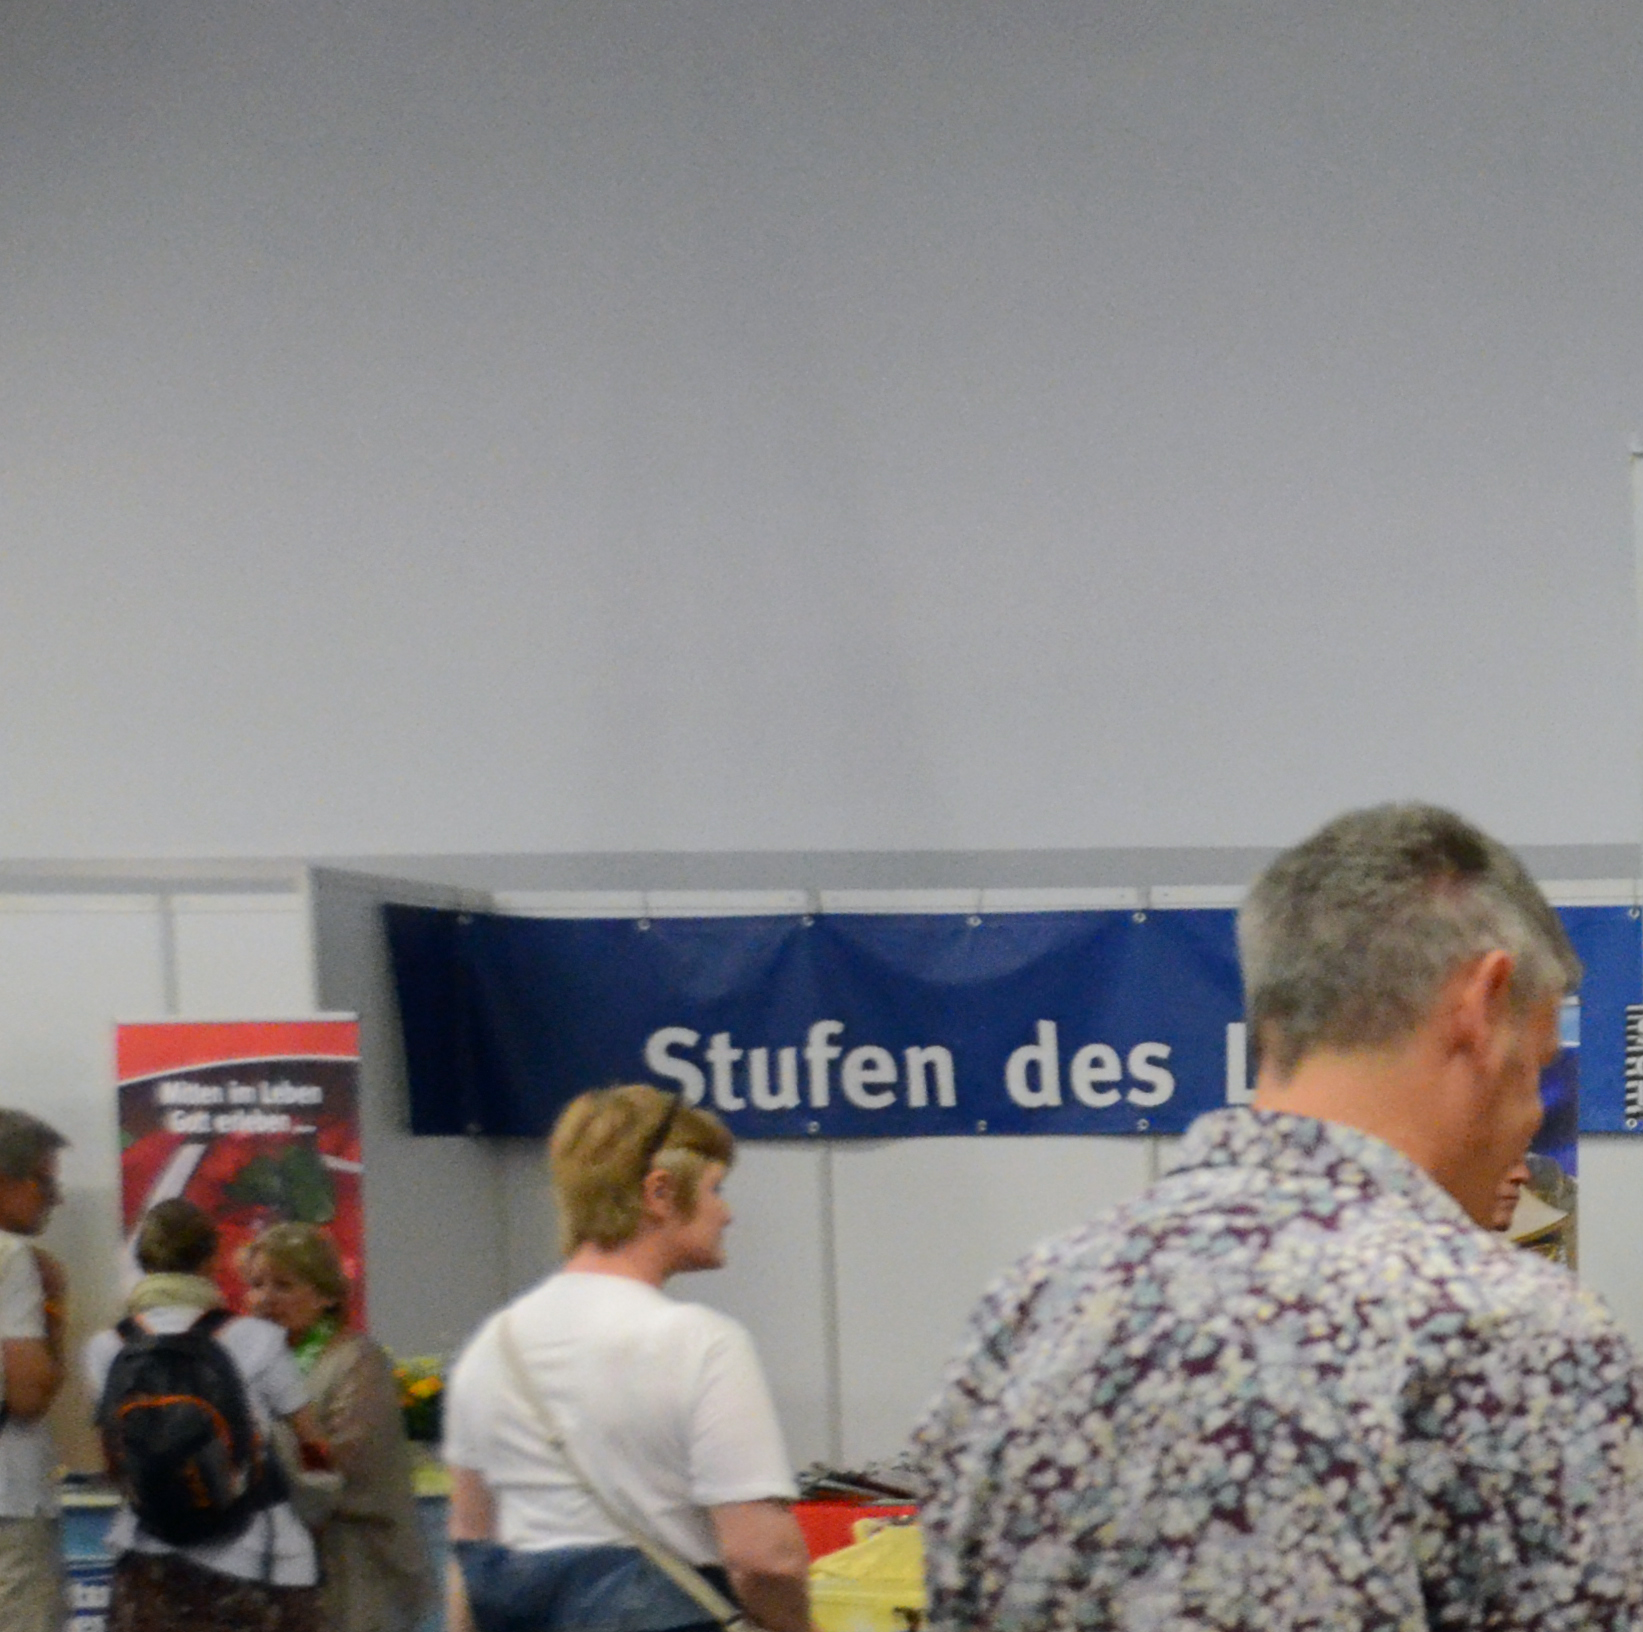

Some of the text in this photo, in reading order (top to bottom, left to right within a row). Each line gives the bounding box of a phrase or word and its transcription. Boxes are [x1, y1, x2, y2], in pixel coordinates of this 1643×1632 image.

[227, 1079, 257, 1105] im
[259, 1079, 323, 1105] Leben
[643, 1019, 957, 1114] Stufen
[1006, 1018, 1174, 1109] des
